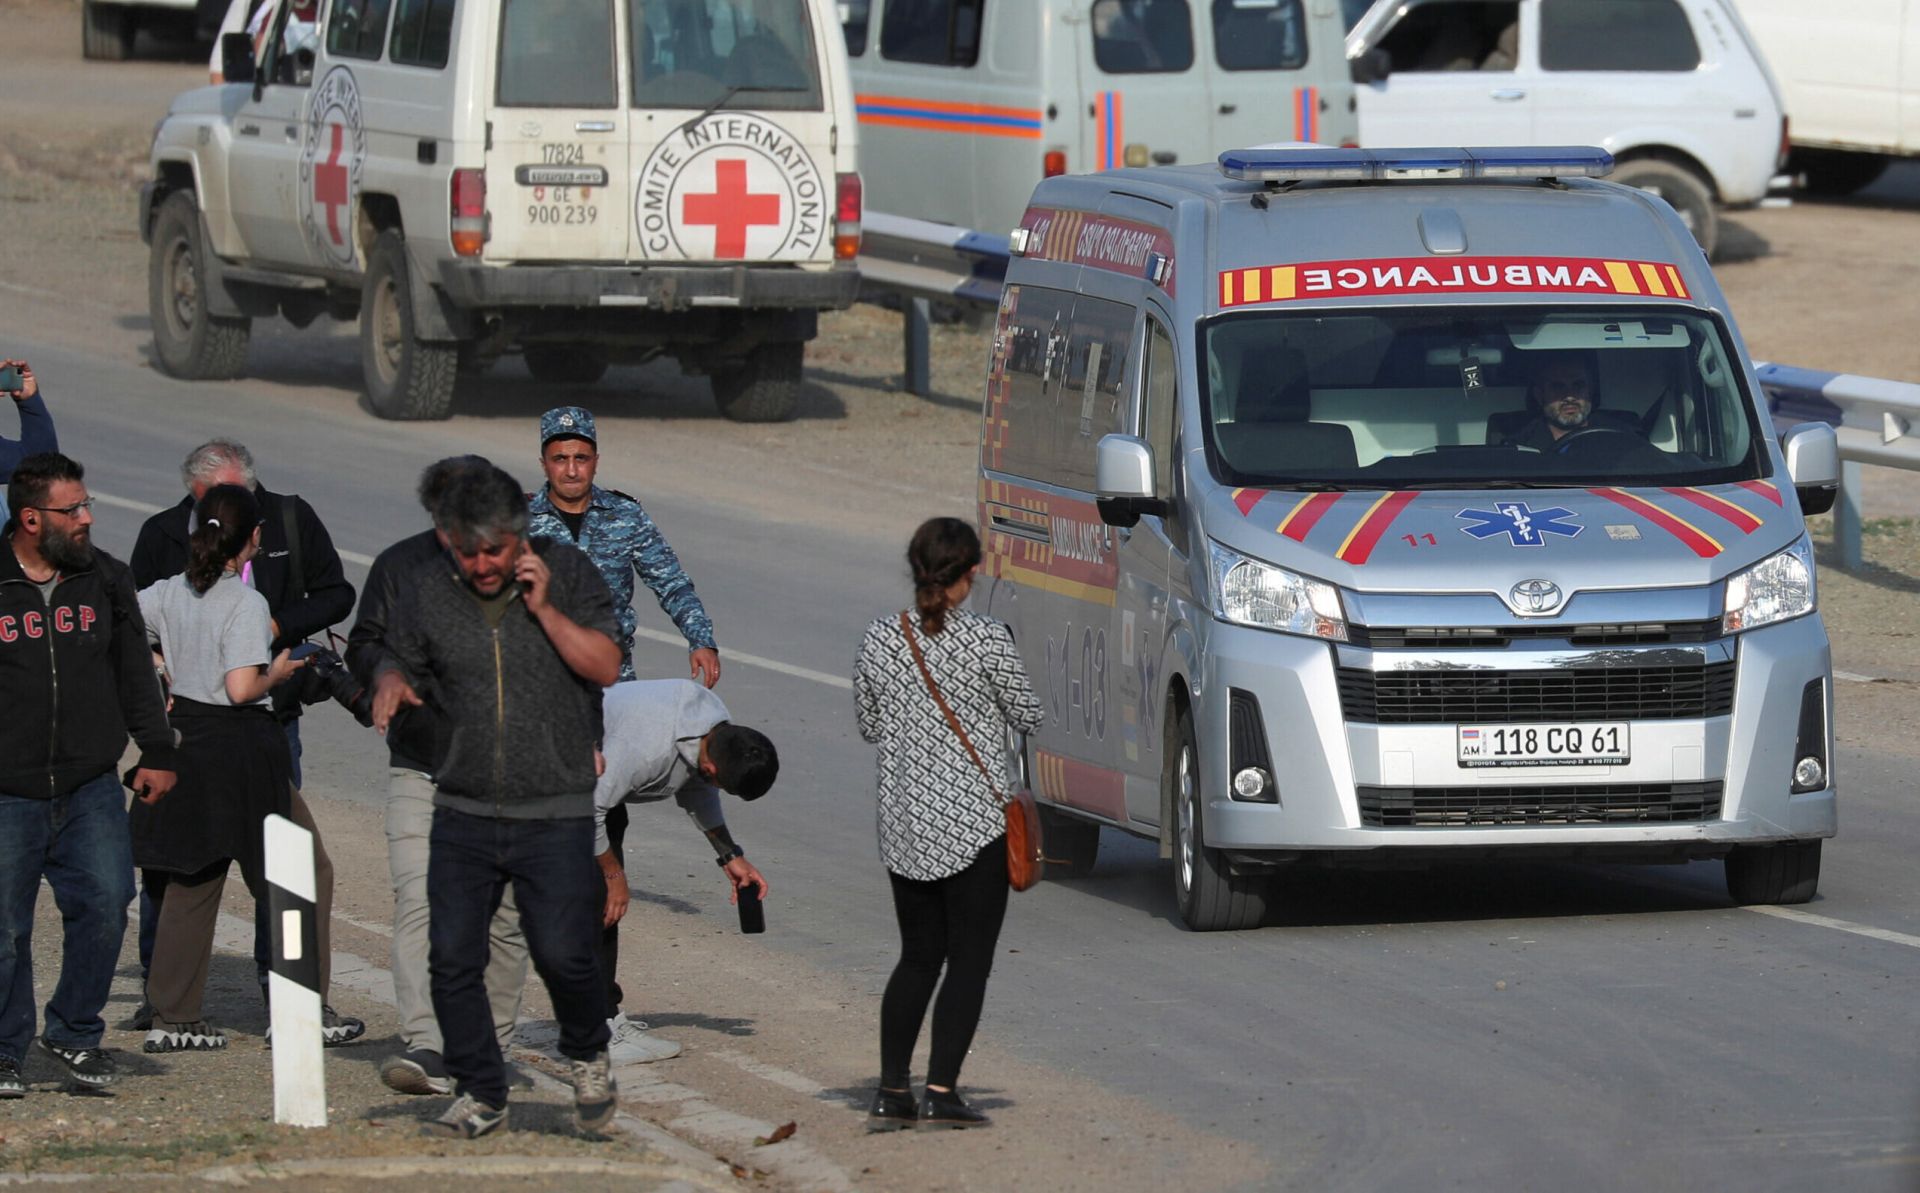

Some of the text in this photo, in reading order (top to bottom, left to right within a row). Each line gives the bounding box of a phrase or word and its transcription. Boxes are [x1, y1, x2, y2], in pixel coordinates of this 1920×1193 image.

[541, 143, 584, 164] 17824
[553, 187, 571, 203] GE
[644, 119, 818, 252] COMITE INTERNATIONAL
[528, 205, 597, 224] 900 239
[1052, 515, 1104, 565] AMBULANCE
[1402, 533, 1437, 547] 11
[1462, 745, 1481, 757] AM
[1493, 728, 1538, 756] 118
[1547, 727, 1583, 755] CQ
[1591, 727, 1621, 754] 61
